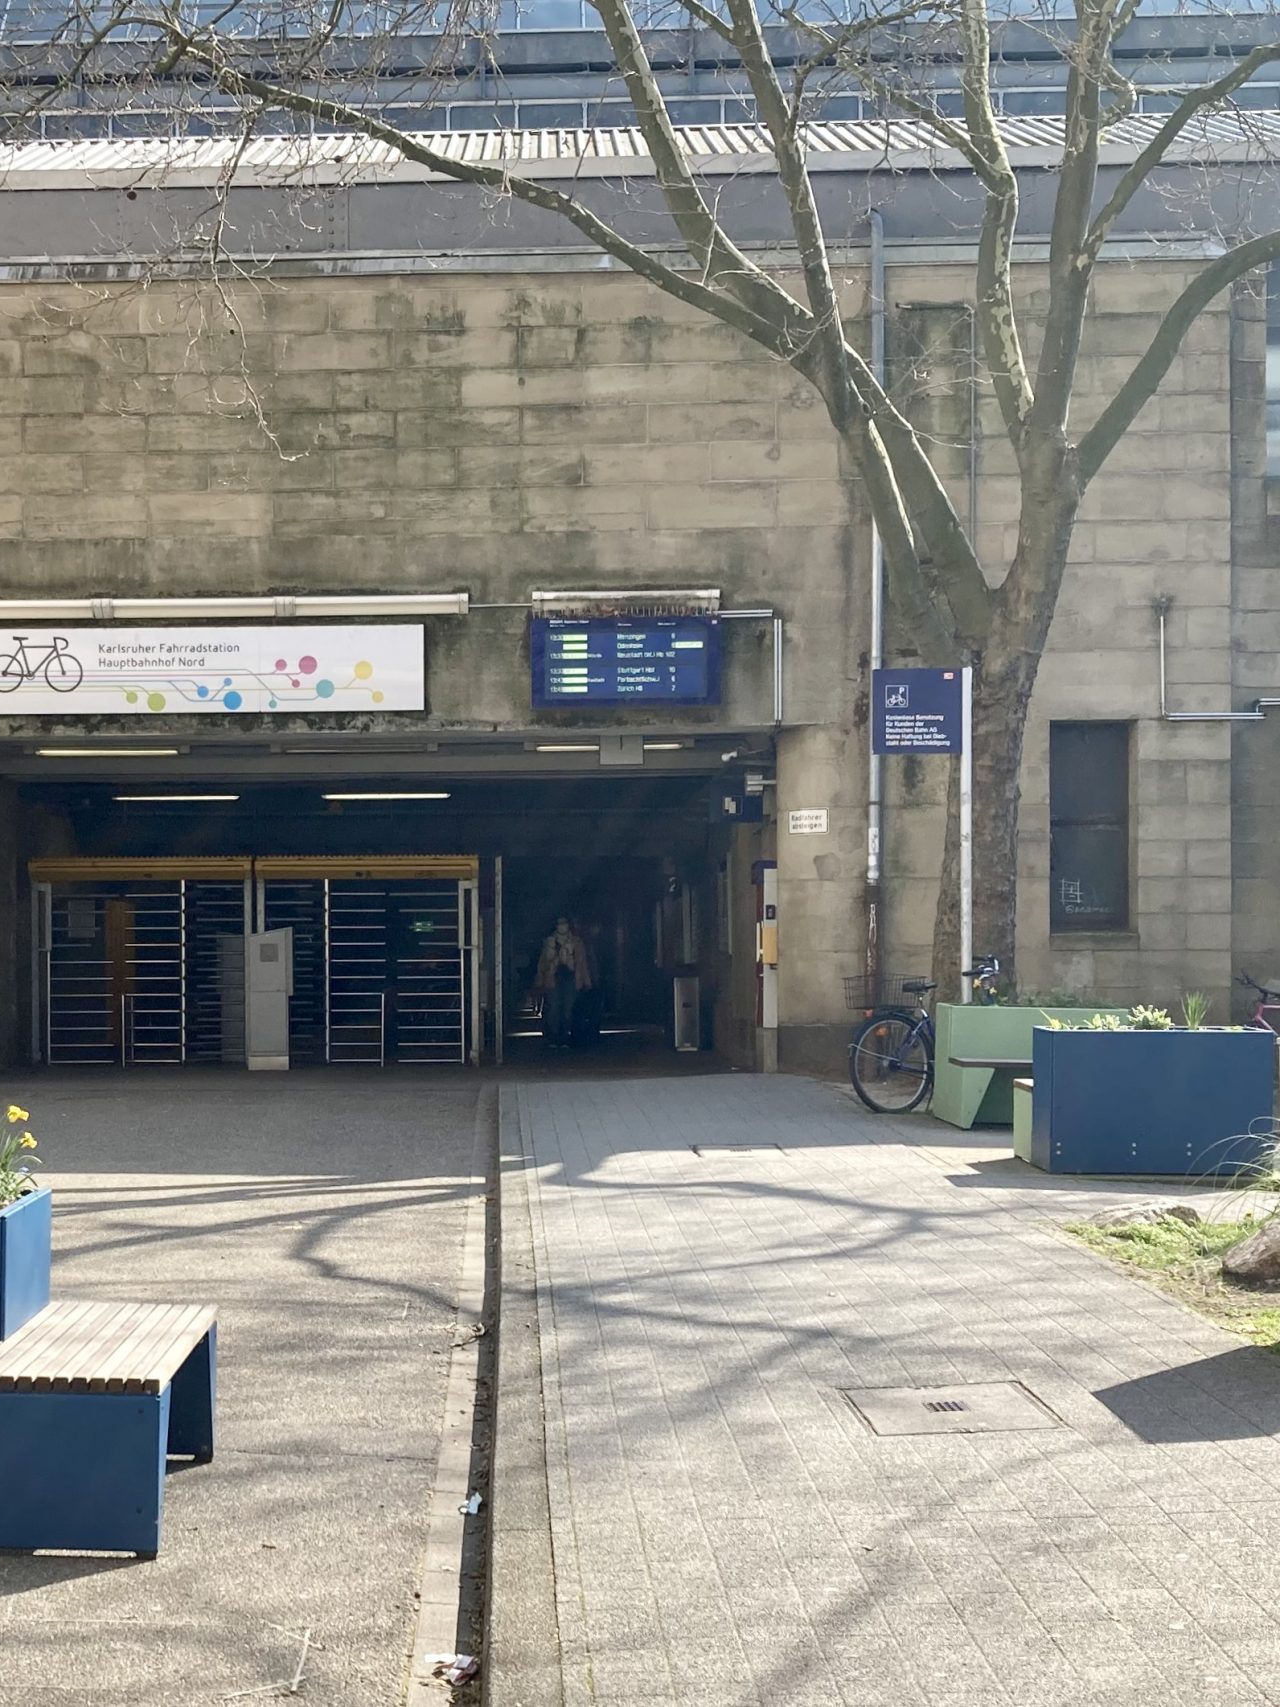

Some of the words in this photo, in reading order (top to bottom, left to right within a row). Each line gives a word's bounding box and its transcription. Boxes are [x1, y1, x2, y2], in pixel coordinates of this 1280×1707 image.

[98, 643, 156, 654] Karlsruher
[159, 642, 240, 653] Fahrradstation
[98, 657, 175, 669] Hauptbahnhof
[178, 656, 205, 667] Nord
[617, 666, 644, 674] Stuttgart
